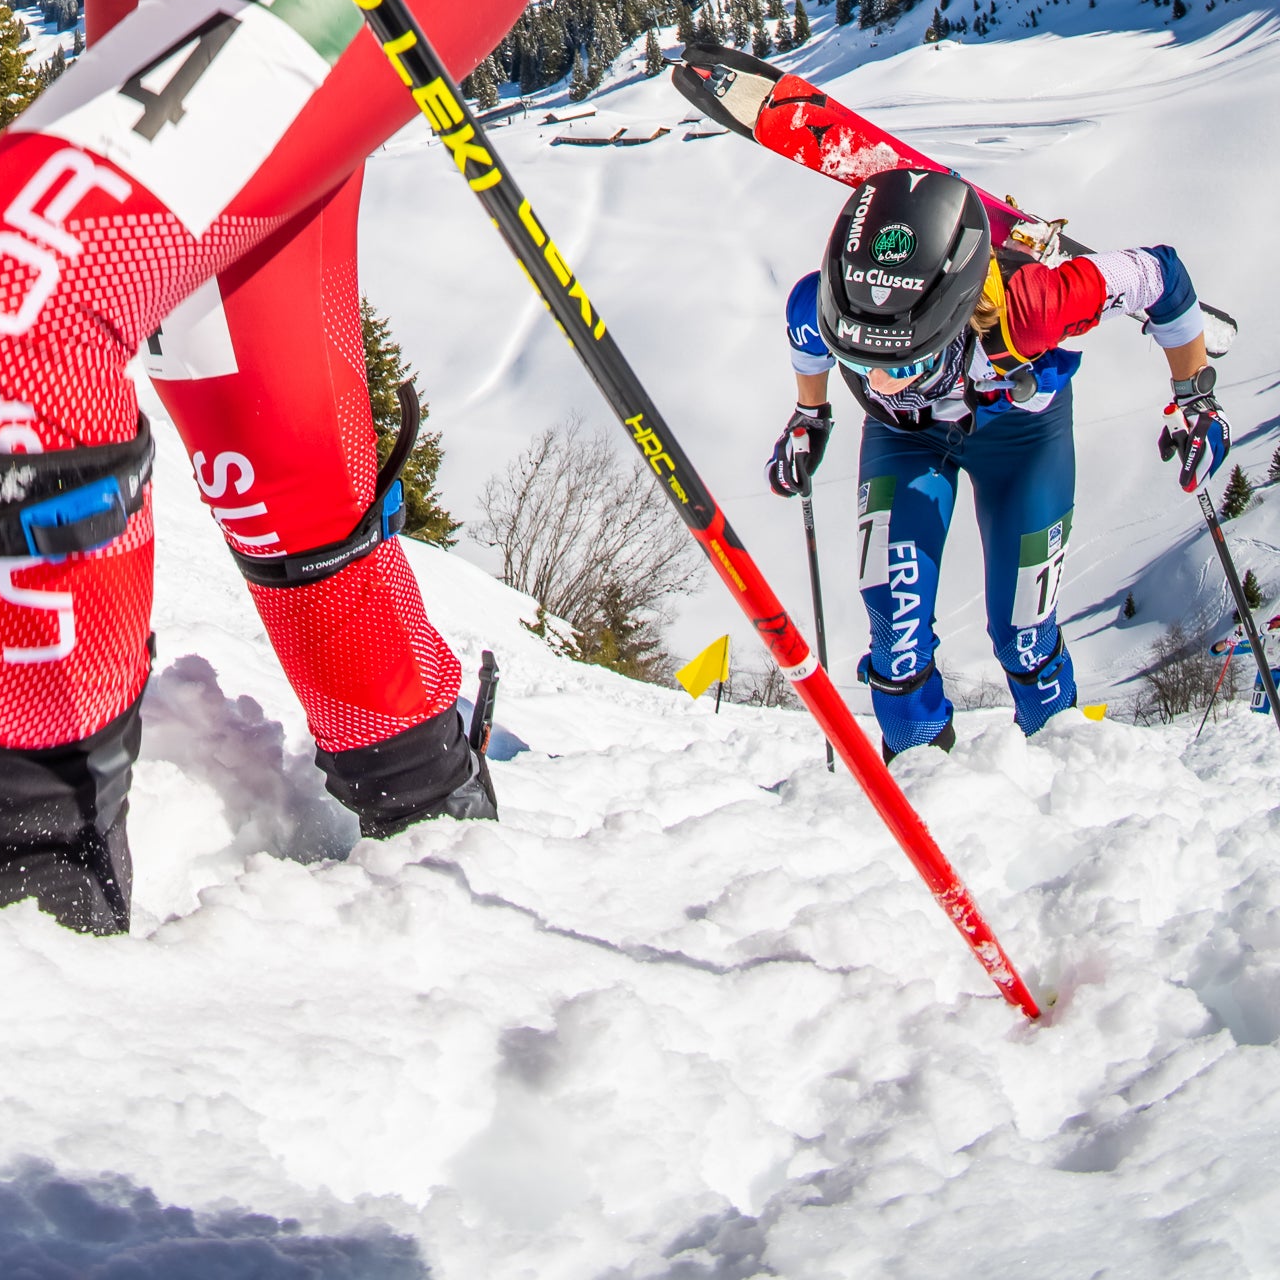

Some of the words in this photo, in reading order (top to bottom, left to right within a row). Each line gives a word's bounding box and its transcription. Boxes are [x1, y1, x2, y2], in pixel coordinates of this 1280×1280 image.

[117, 8, 243, 142] 4
[383, 29, 503, 192] LEKI
[846, 184, 877, 253] ATOMIC
[845, 265, 865, 283] La
[866, 269, 925, 291] Clusaz
[864, 338, 912, 348] MONOD
[867, 327, 913, 336] GROUPE
[624, 412, 676, 476] HRC
[1184, 436, 1202, 472] KINETIX
[192, 450, 288, 558] SU
[1035, 551, 1066, 616] 17
